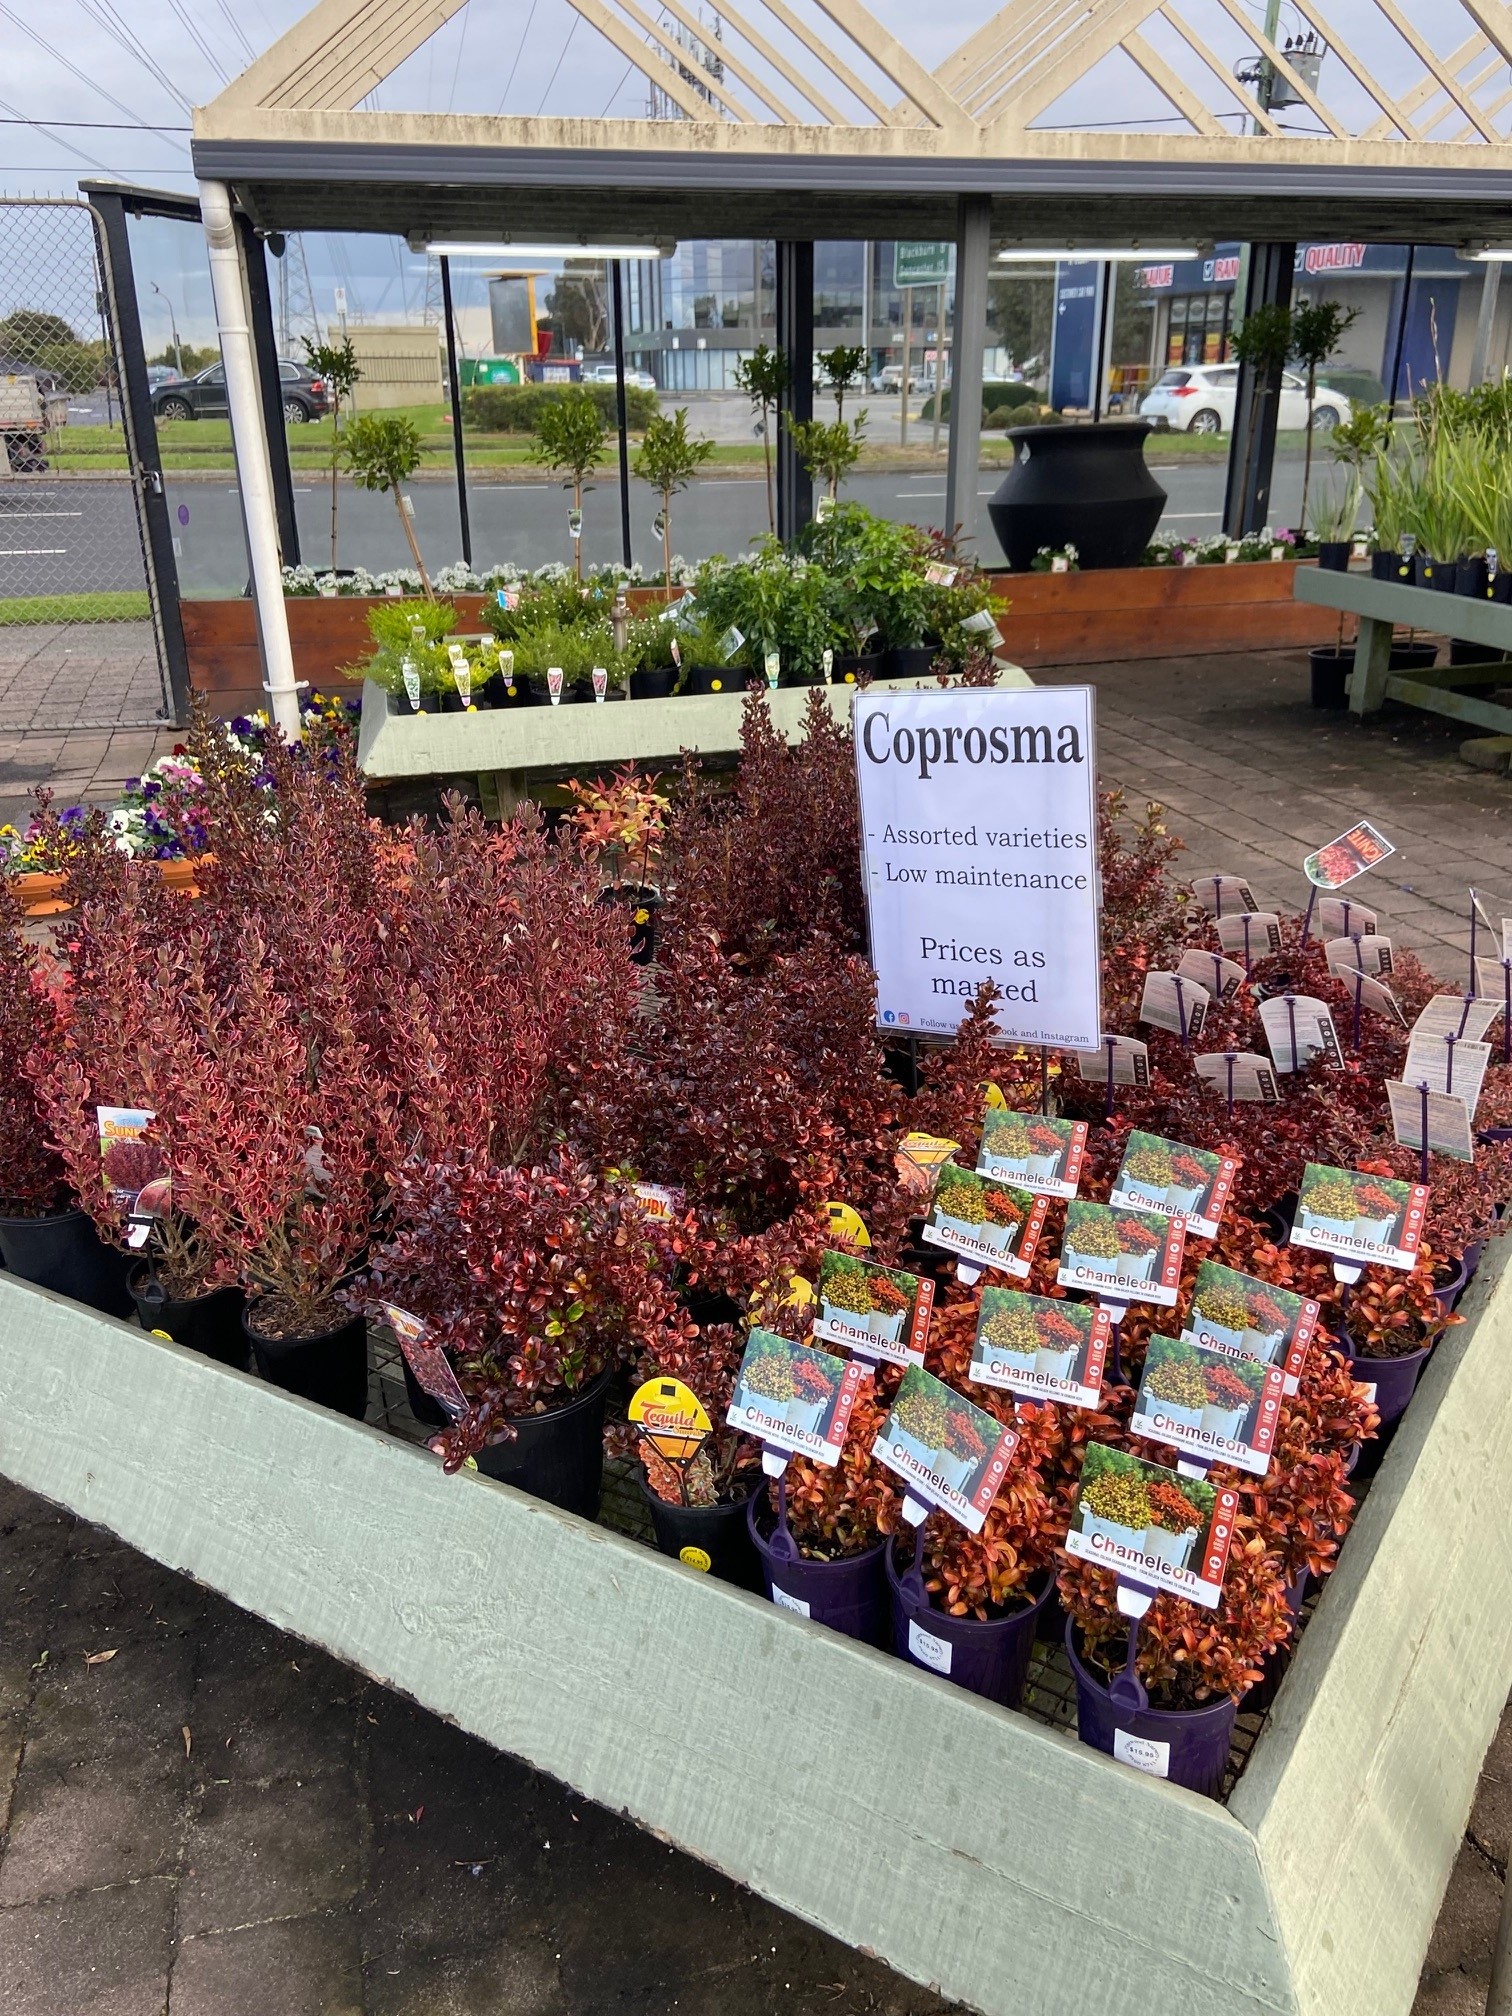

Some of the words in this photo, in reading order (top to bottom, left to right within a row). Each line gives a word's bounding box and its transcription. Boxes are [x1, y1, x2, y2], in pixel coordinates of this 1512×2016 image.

[1305, 243, 1366, 274] QUALITY
[863, 711, 1084, 779] Coprosma
[883, 824, 978, 846] Assorted
[986, 828, 1088, 849] varieties
[886, 862, 927, 882] Low
[935, 866, 1088, 890] maintenance
[920, 937, 1002, 964] Prices
[1014, 950, 1046, 968] as
[920, 1018, 947, 1028] Follow
[1020, 1030, 1038, 1038] and
[1041, 1030, 1089, 1043] Instagram
[991, 1166, 1060, 1188] Chameleon
[1128, 1190, 1200, 1224] Chameleon
[942, 1226, 1014, 1262] Chameleon
[1310, 1226, 1394, 1255] Chameleon
[1076, 1266, 1158, 1292] Chameleon
[830, 1320, 906, 1354] Chameleon
[1200, 1332, 1270, 1366] Chamee
[990, 1361, 1078, 1392] Chameleon
[641, 1401, 696, 1430] Tequila
[746, 1406, 824, 1448] Chameleon
[1153, 1414, 1247, 1455] Chameleon
[893, 1444, 968, 1509] Chameleon
[1091, 1533, 1196, 1586] Chameleon
